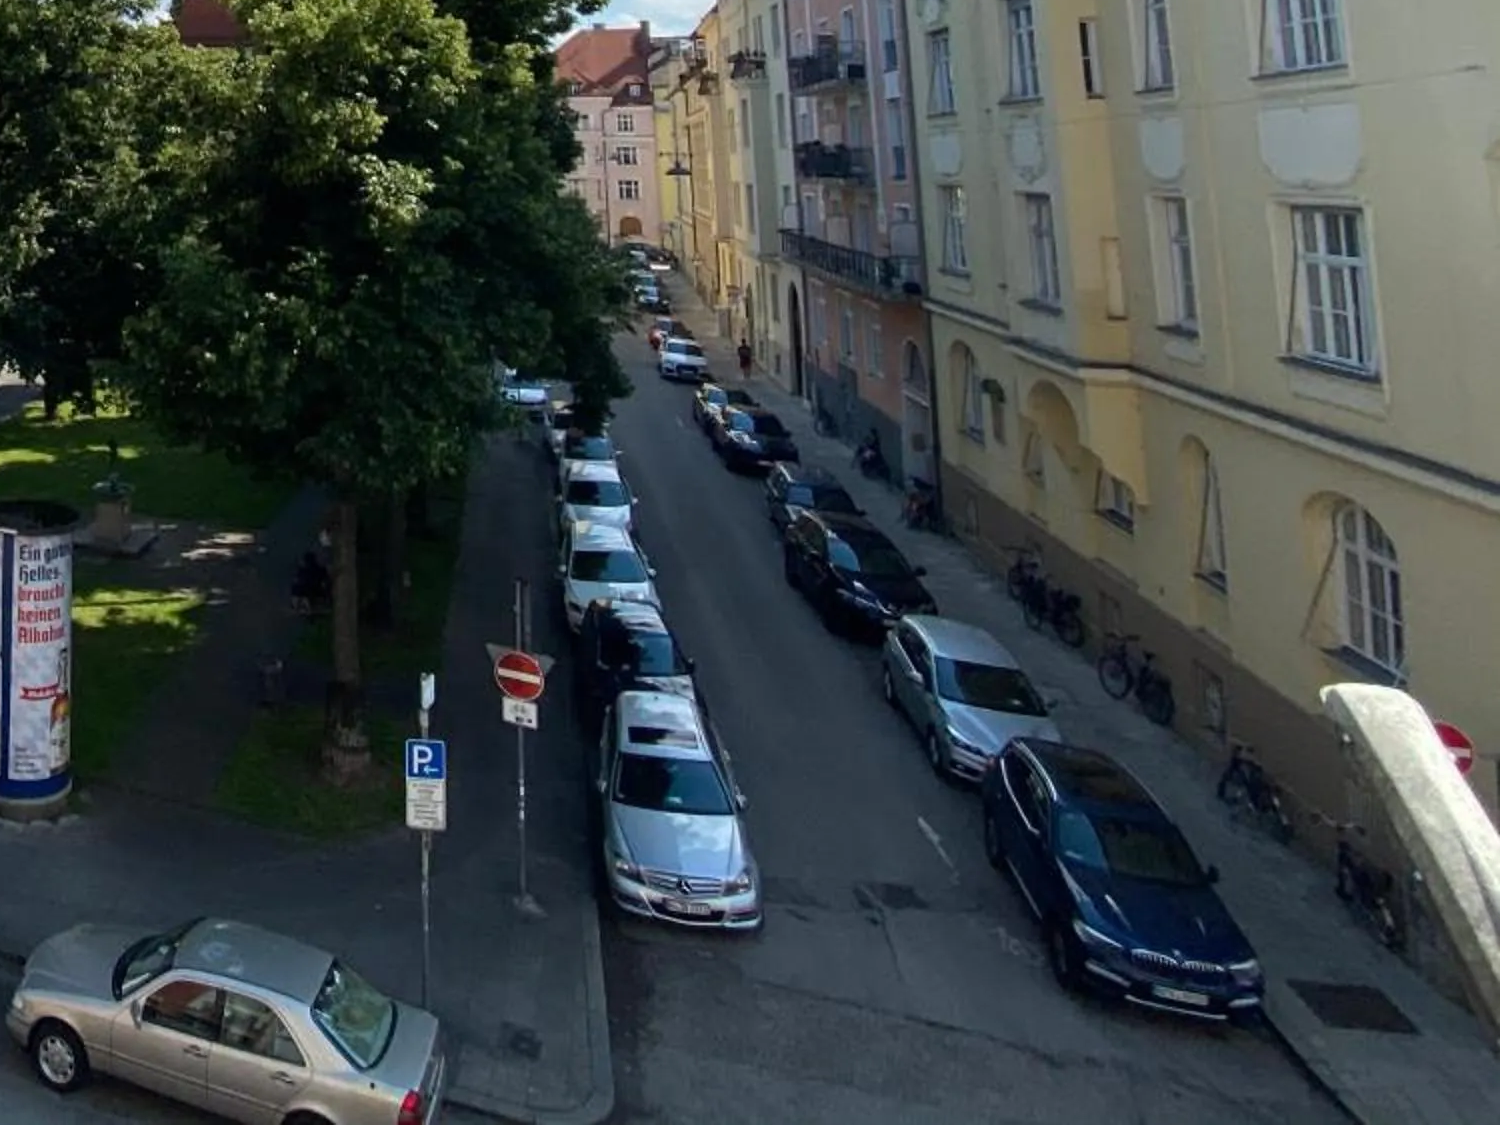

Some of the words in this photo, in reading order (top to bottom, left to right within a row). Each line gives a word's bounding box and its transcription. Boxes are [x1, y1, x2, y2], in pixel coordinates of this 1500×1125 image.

[20, 544, 40, 561] Ein
[19, 583, 65, 601] braucht
[19, 607, 60, 623] keinen
[413, 745, 433, 774] P
